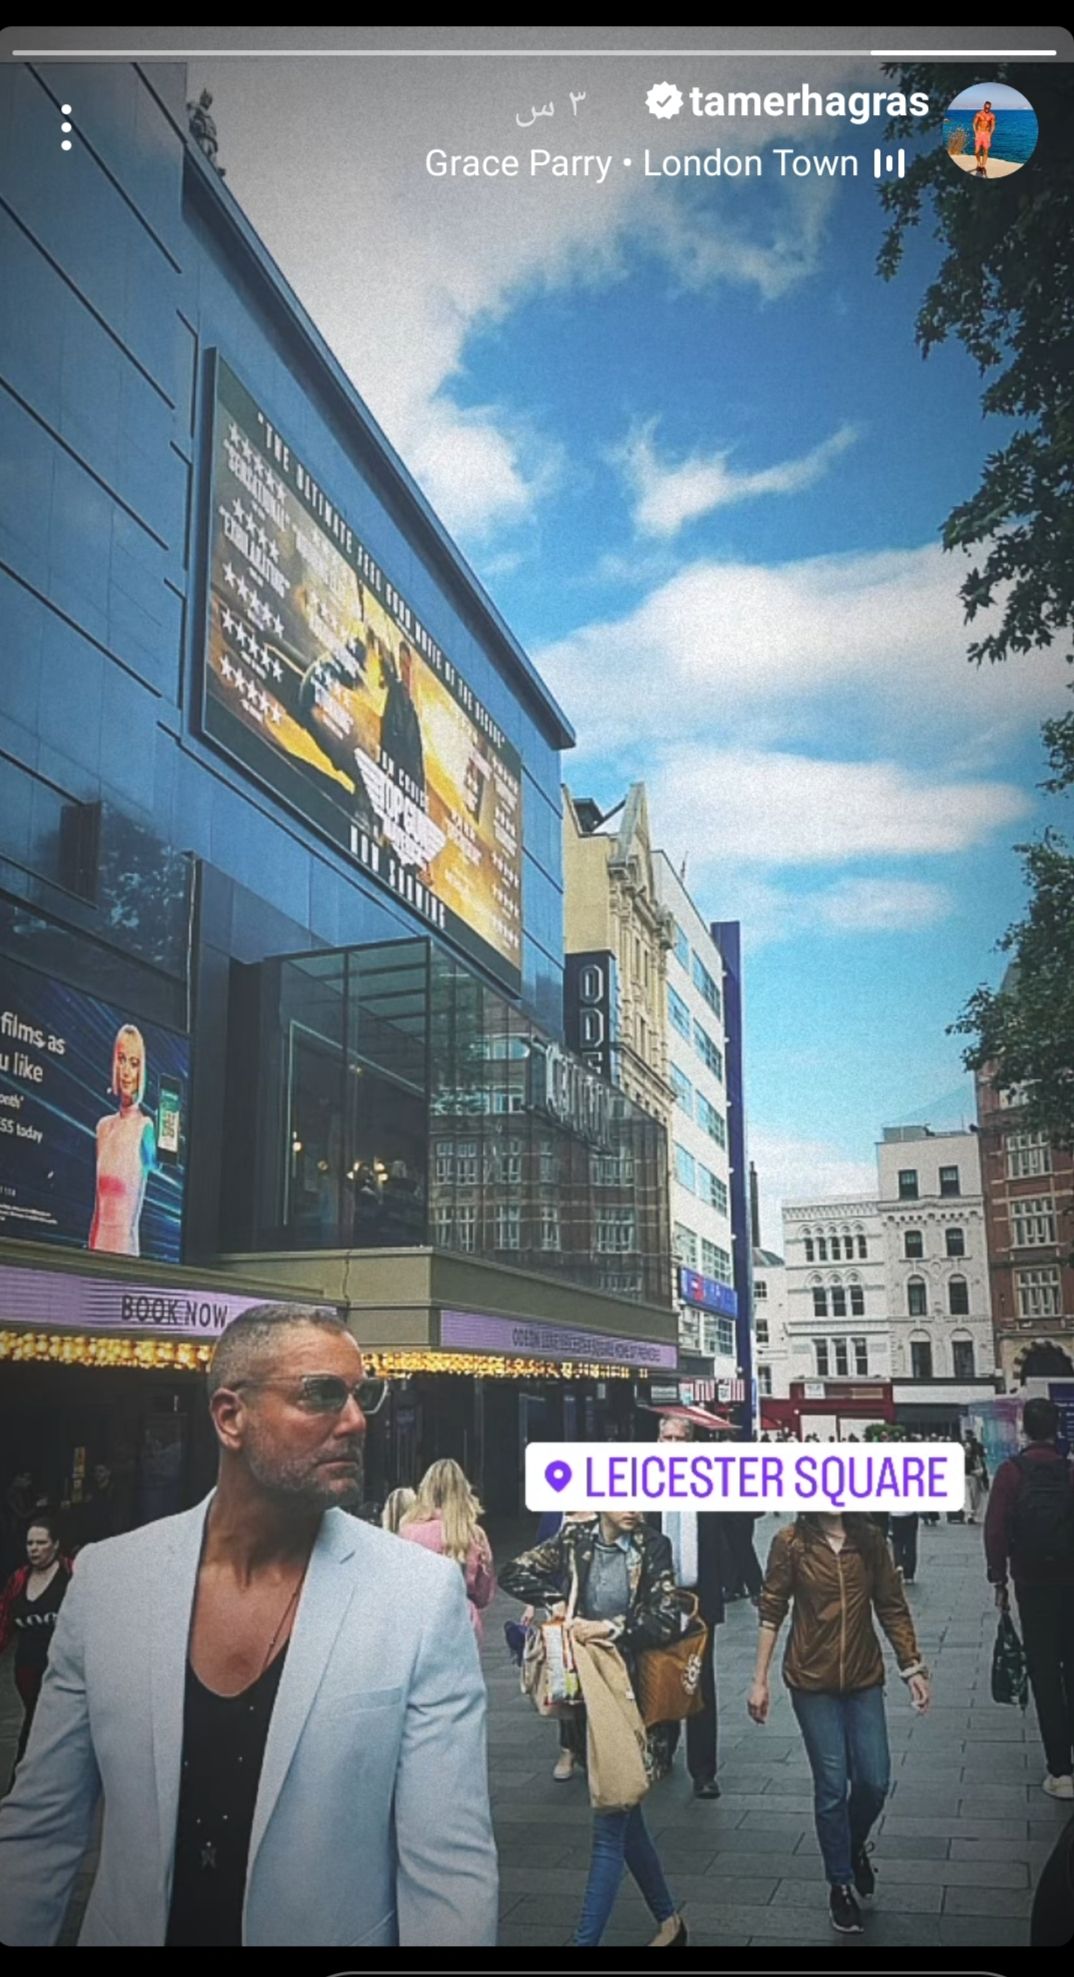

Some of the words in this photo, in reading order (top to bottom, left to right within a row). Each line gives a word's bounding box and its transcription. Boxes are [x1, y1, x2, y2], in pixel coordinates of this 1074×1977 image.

[295, 462, 354, 555] ULTIMATE
[1, 1011, 45, 1048] films
[47, 1034, 65, 1055] as
[13, 1051, 43, 1083] like
[16, 1122, 43, 1144] today
[121, 1294, 178, 1325] BOOK
[184, 1300, 229, 1328] NOW
